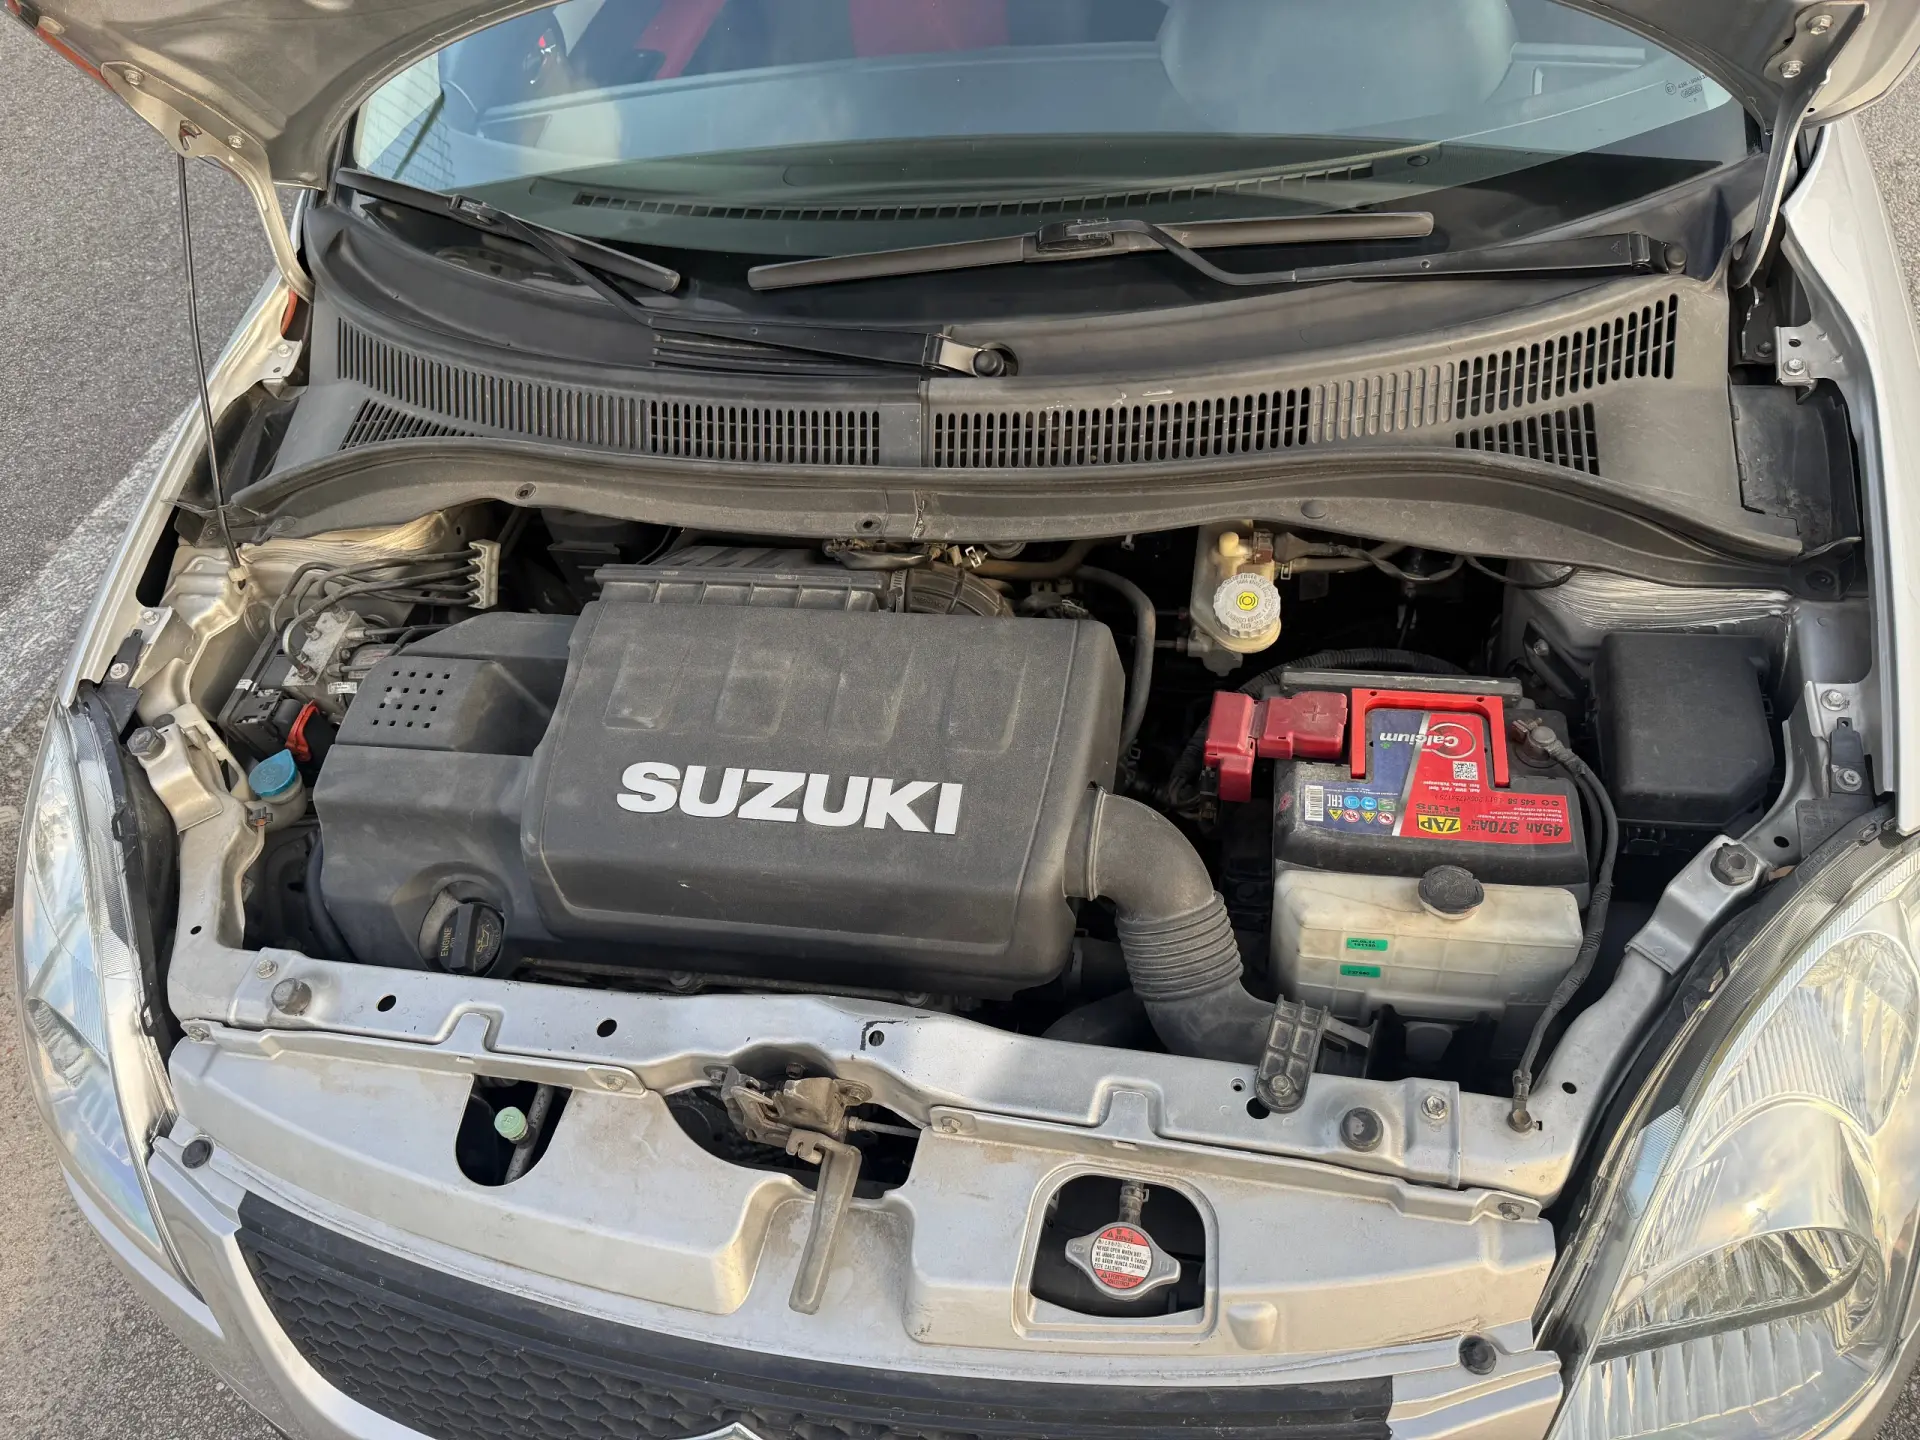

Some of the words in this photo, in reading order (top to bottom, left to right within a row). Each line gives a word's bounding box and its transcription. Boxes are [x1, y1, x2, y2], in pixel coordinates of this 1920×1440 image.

[1380, 732, 1458, 747] Calcium
[616, 761, 963, 835] SUZUKI
[1326, 794, 1342, 807] EAC
[1416, 803, 1460, 812] PLUS
[1420, 816, 1460, 832] ZAP
[1479, 820, 1519, 834] 370A
[1526, 822, 1564, 837] 45Ah
[440, 927, 452, 957] ENGINE
